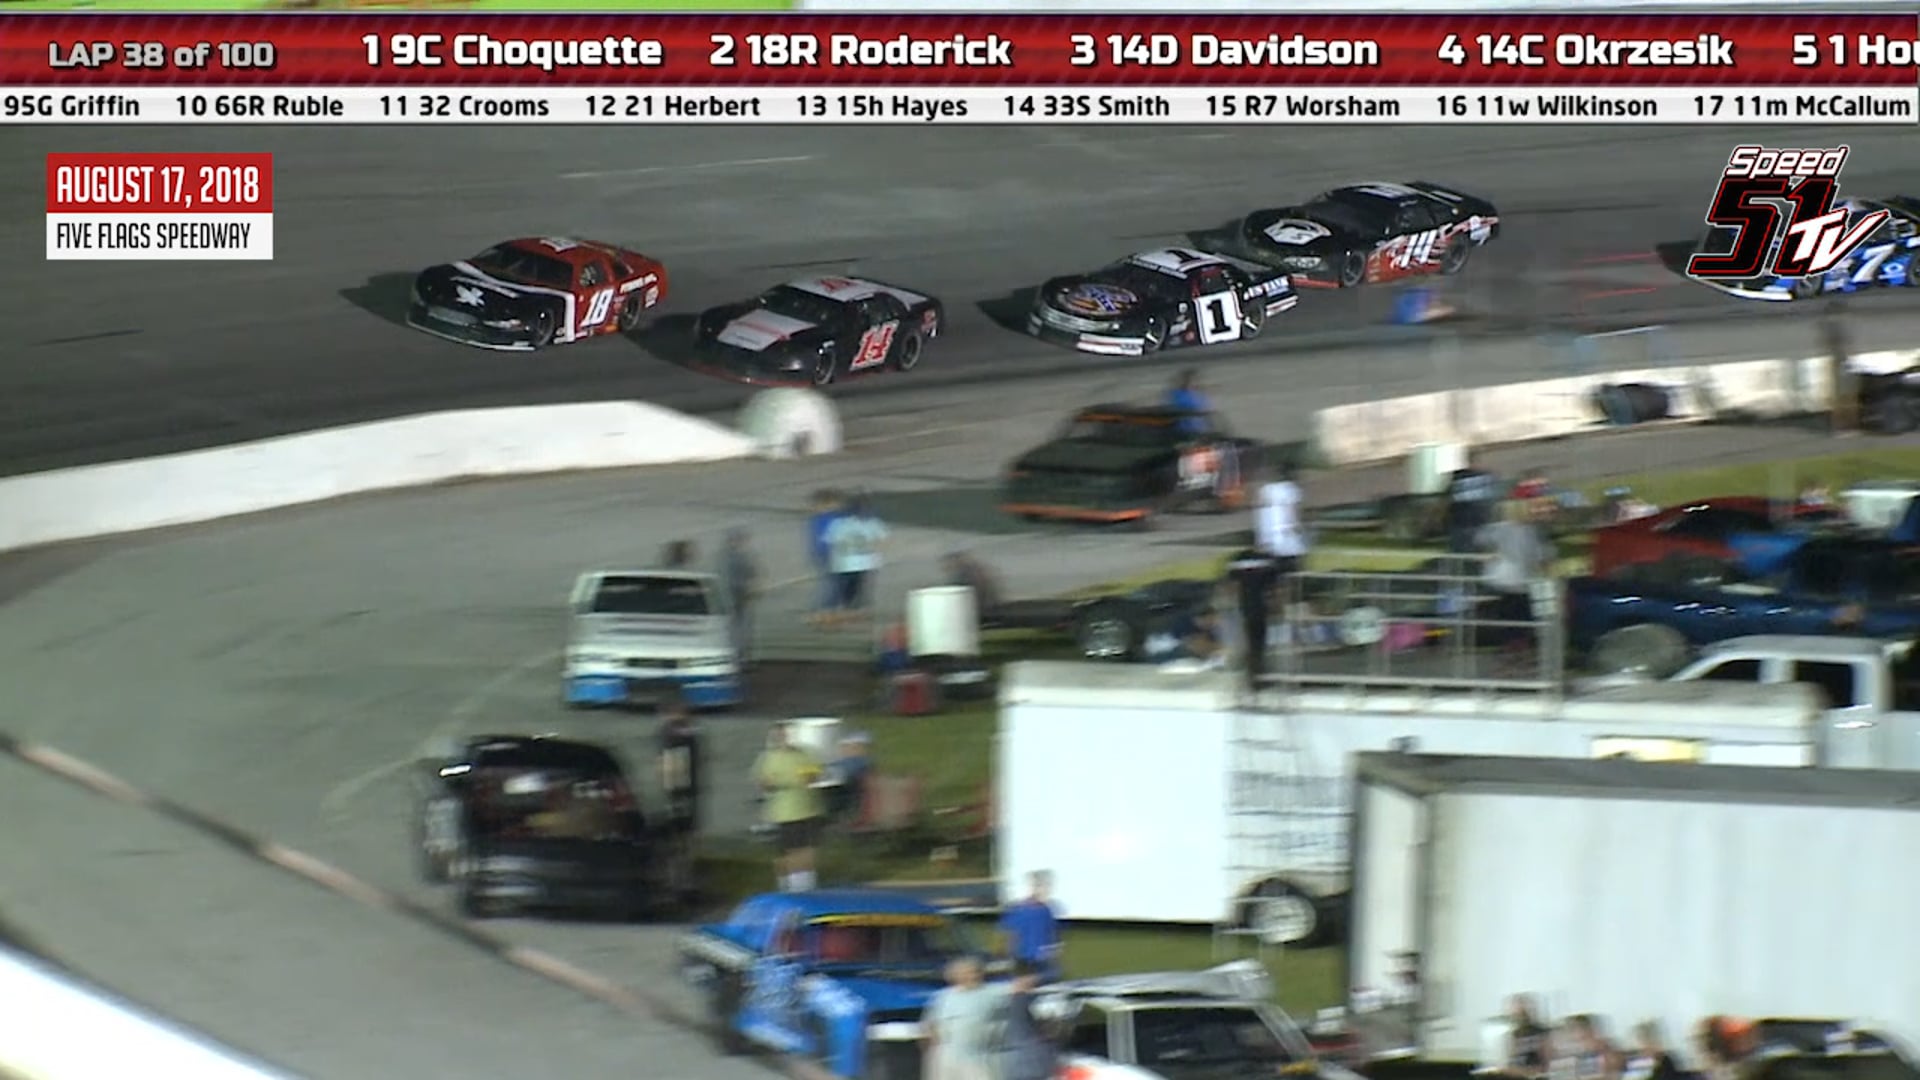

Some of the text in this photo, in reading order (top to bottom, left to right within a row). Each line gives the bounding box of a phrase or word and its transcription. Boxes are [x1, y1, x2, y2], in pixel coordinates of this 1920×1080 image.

[1851, 242, 1897, 284] 7
[581, 288, 615, 327] 18
[1206, 298, 1232, 335] 1
[851, 321, 899, 370] 14
